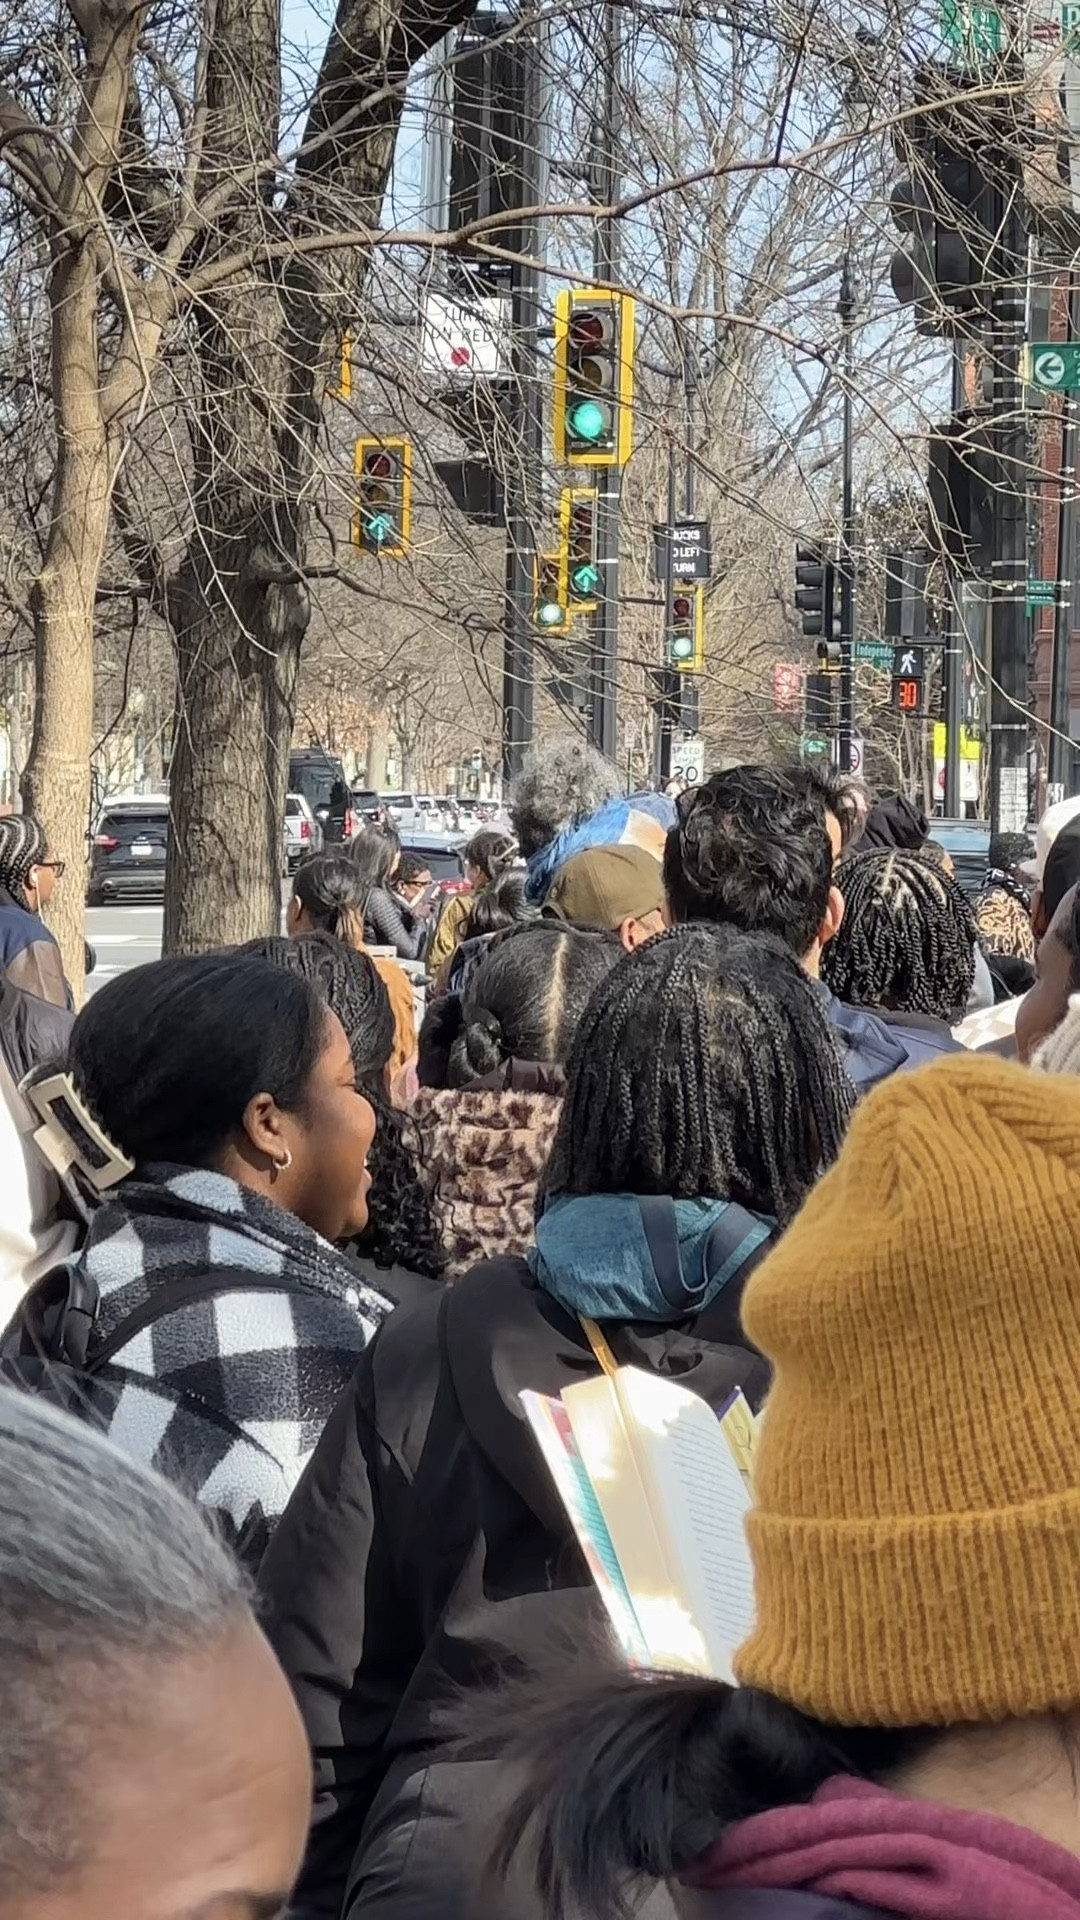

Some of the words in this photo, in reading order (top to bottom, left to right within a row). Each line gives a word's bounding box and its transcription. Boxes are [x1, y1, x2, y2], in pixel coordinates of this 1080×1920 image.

[899, 682, 917, 707] 30
[671, 746, 701, 755] SPEED
[672, 765, 699, 782] 20
